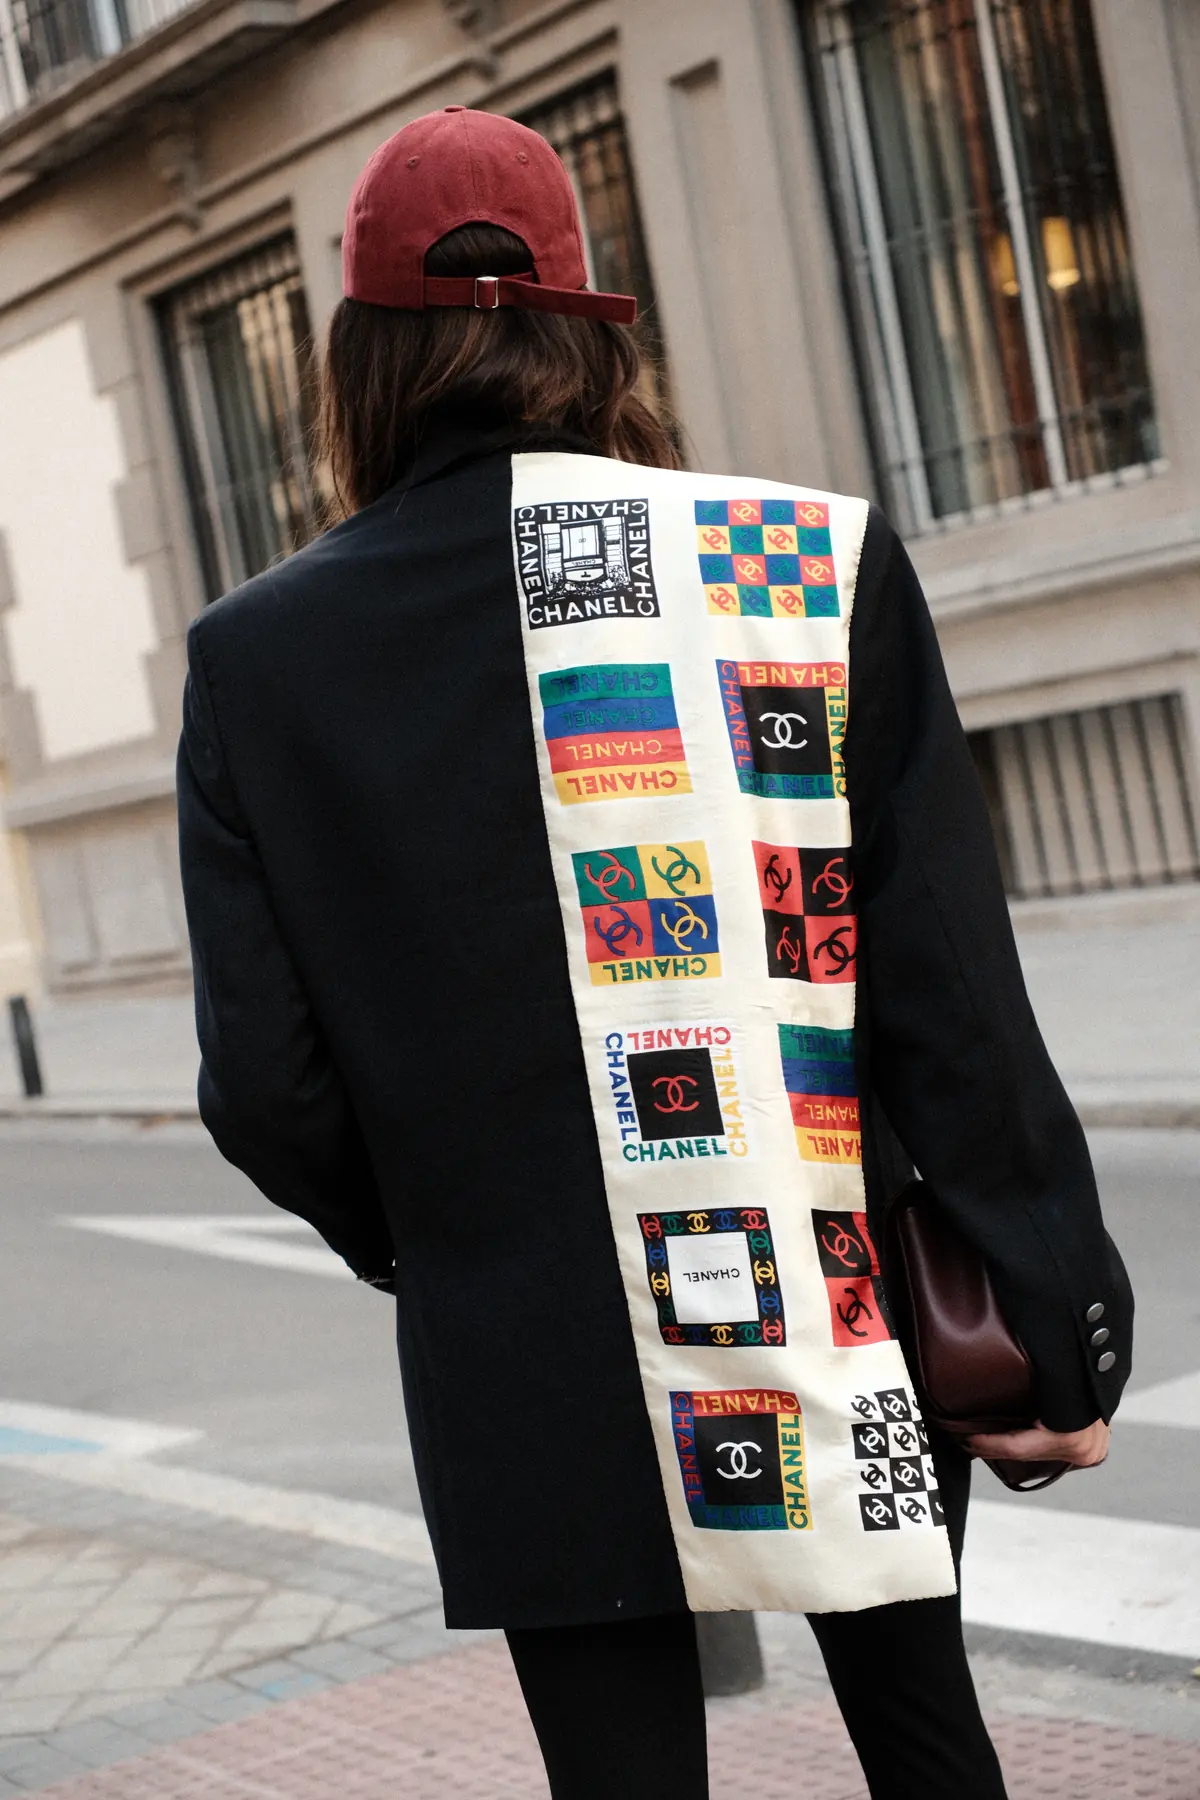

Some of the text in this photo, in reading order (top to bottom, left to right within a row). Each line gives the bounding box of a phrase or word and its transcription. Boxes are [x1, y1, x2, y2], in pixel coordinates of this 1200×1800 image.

[540, 501, 647, 521] CHANEL
[518, 506, 543, 605] CHANEL
[628, 515, 655, 616] CHANEL
[529, 596, 634, 624] CHANEL
[551, 671, 659, 696] CHANEL
[739, 666, 845, 684] CHANEL
[560, 706, 657, 729] CHANEL
[721, 661, 752, 768] CHANEL
[565, 739, 662, 761] CHANEL
[566, 770, 678, 796] CHANEL
[737, 771, 834, 796] CHANEL
[602, 957, 707, 982] CHANEL
[627, 1026, 731, 1051] CHANEL
[791, 1032, 854, 1055] HANEL
[605, 1032, 638, 1141] CHANEL
[713, 1047, 748, 1157] CHANEL
[804, 1103, 859, 1122] HANEL
[622, 1138, 727, 1163] CHANEL
[807, 1135, 861, 1158] HANEL
[683, 1268, 740, 1283] CHANEL
[693, 1392, 798, 1413] CHANEL
[673, 1393, 703, 1503] CHANEL
[781, 1415, 809, 1529] CHANEL
[703, 1506, 787, 1528] HANEL
